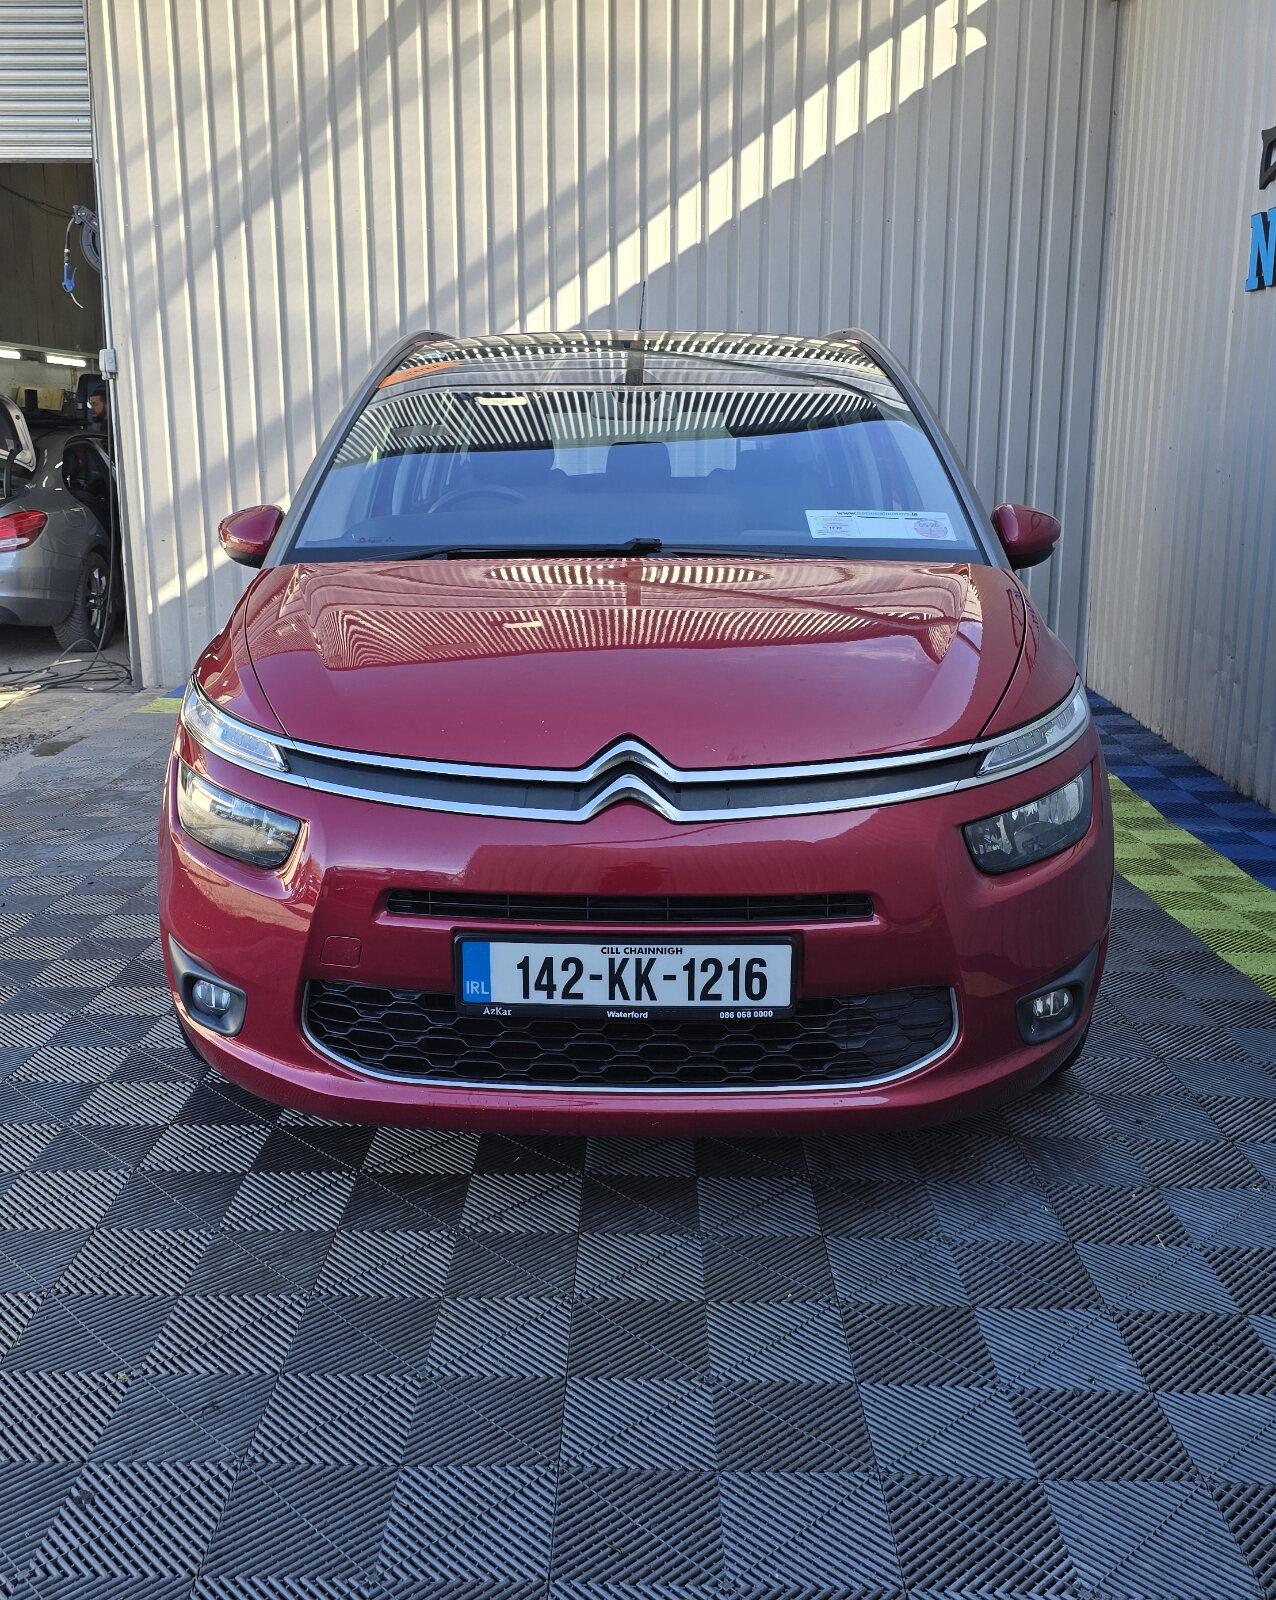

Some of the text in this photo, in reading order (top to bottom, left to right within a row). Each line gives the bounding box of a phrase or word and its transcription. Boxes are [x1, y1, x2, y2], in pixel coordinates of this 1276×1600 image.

[600, 946, 683, 955] CILL CHAINNIGH
[516, 955, 768, 1002] 142-KK-1216
[465, 980, 490, 995] IRL
[482, 1007, 512, 1016] AzKar
[606, 1010, 649, 1019] Waterford
[719, 1011, 735, 1019] 086
[753, 1010, 774, 1018] 0000
